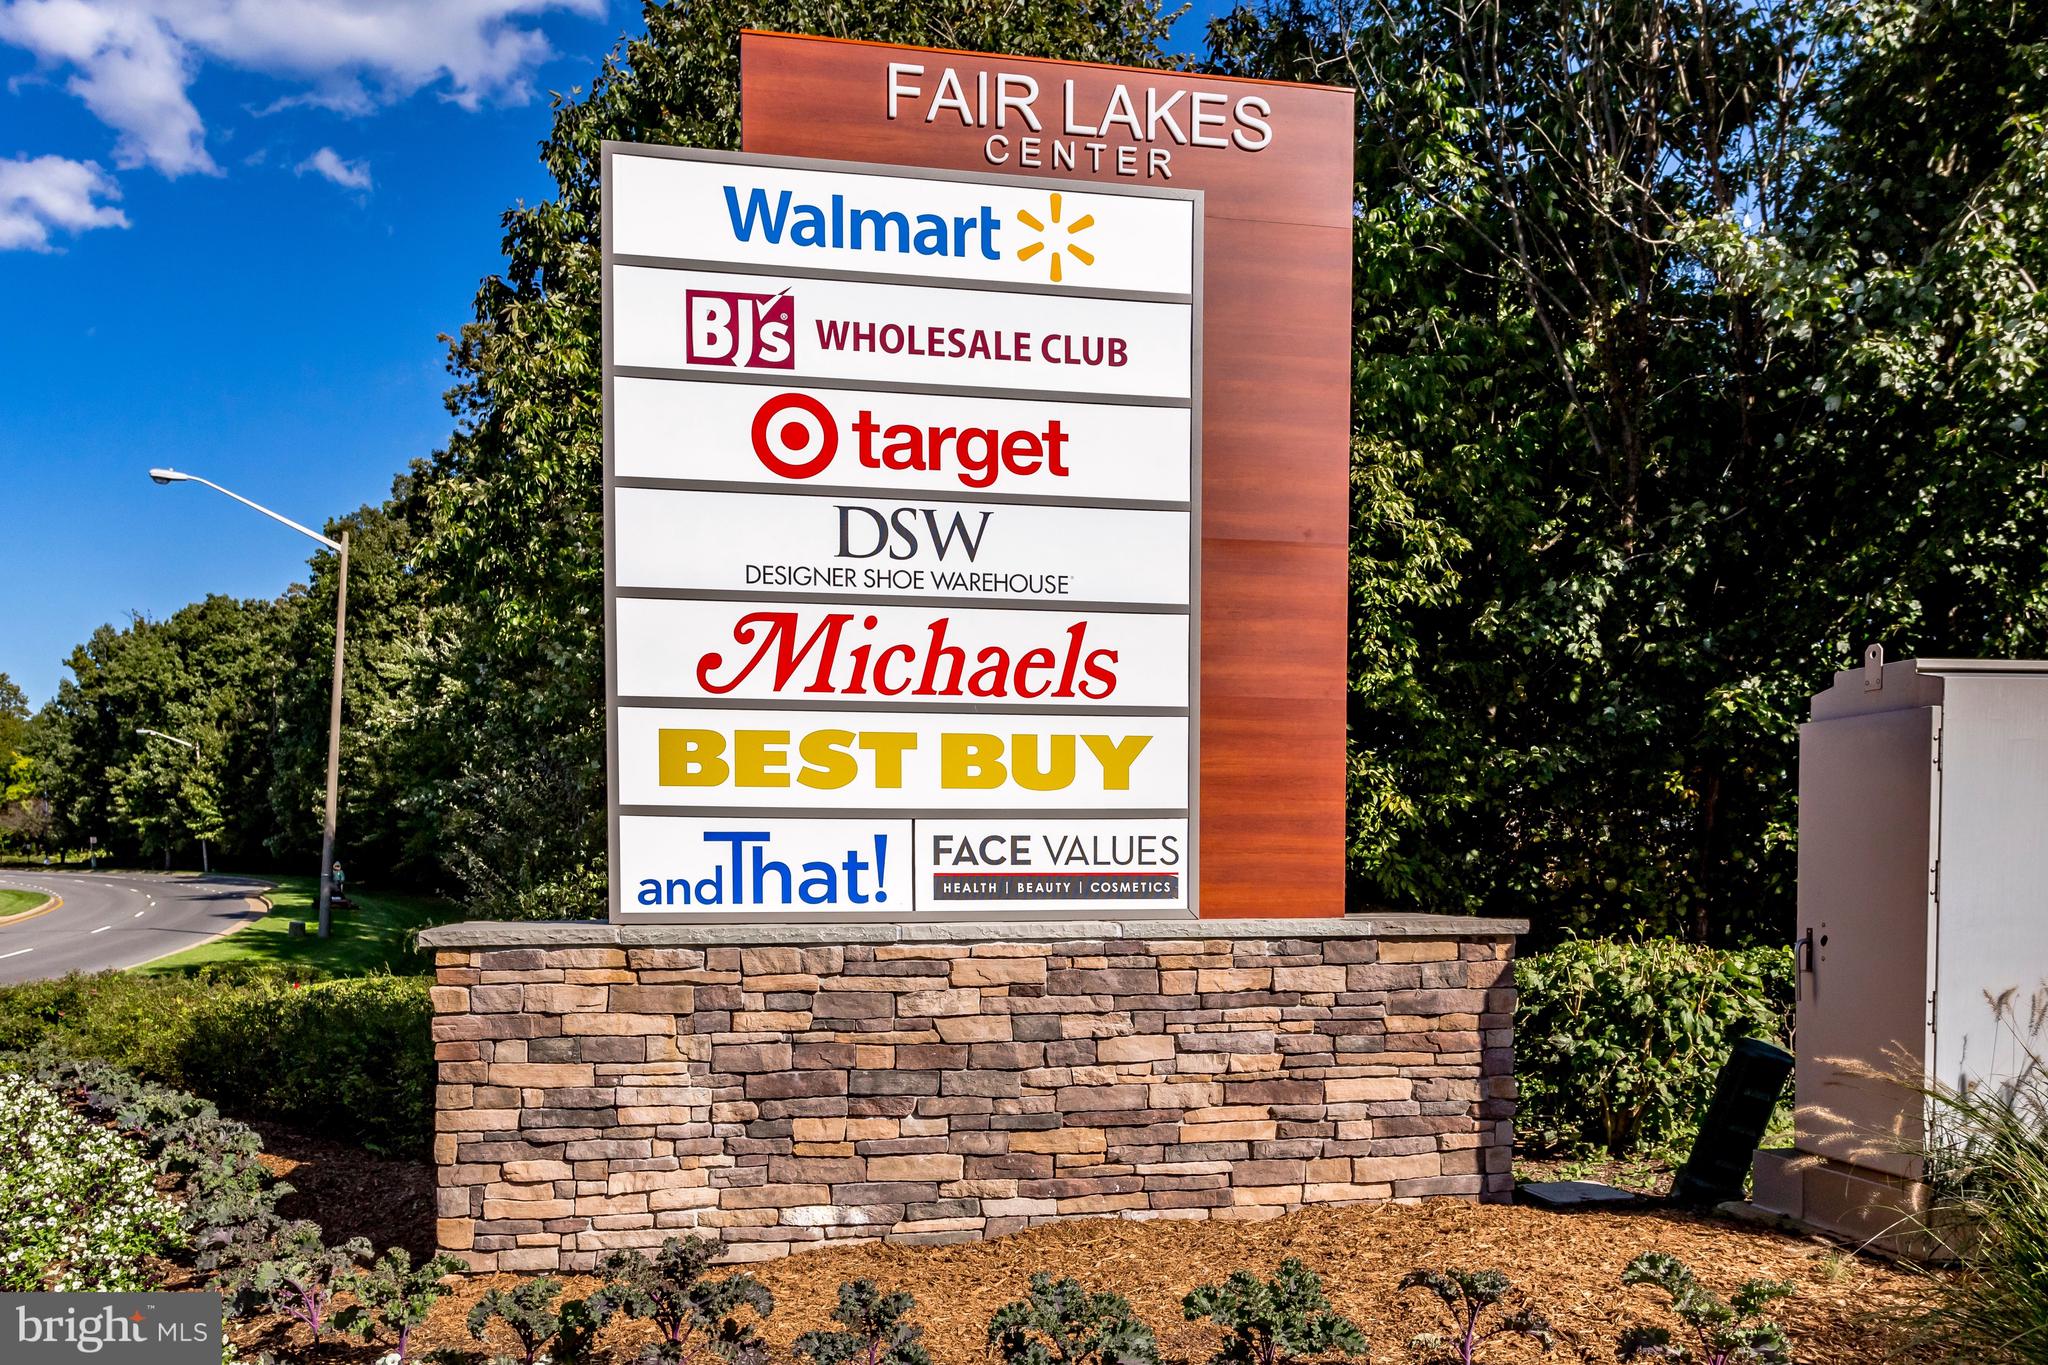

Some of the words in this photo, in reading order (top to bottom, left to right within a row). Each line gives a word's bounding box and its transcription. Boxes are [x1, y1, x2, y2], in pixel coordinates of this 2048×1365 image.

[887, 62, 1041, 131] FAIR
[1065, 79, 1274, 152] LAKES
[985, 134, 1173, 179] CENTER
[723, 186, 1001, 261] Walmart
[815, 319, 1031, 362] WHOLESALE
[1041, 333, 1128, 367] CLUB
[852, 410, 1069, 488] target
[833, 504, 994, 563] DSW
[745, 565, 857, 588] DESIGNER
[864, 568, 925, 590] SHOE
[930, 571, 1069, 594] WAREHOUSE
[697, 612, 1119, 699] Michaels
[658, 729, 918, 789] BEST
[941, 733, 1154, 790] BUY
[933, 835, 1031, 866] FACE
[1042, 835, 1180, 866] VALUES
[943, 882, 997, 893] HEALTH
[1017, 882, 1071, 893] BEAUTY
[1090, 881, 1171, 893] COSMETICS
